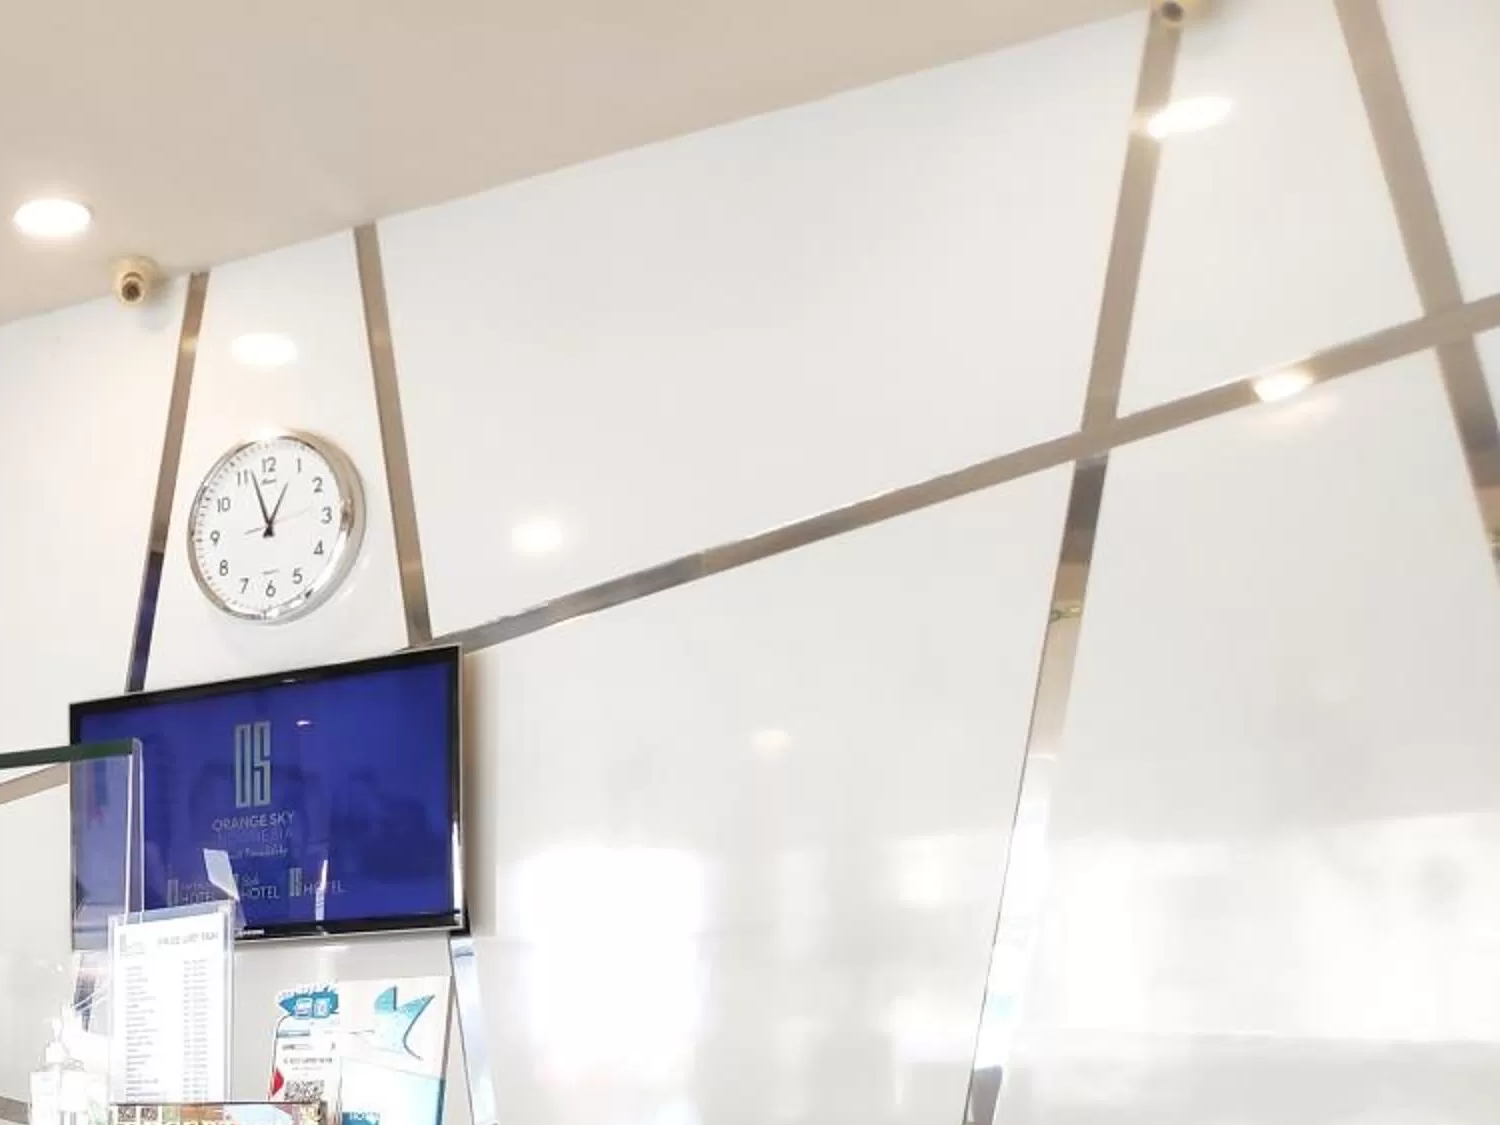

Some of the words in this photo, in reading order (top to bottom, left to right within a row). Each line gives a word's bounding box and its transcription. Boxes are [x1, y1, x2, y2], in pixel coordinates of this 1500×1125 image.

[261, 457, 276, 473] 12
[296, 457, 303, 474] 1
[237, 469, 249, 486] 11
[312, 477, 324, 493] 2
[217, 497, 231, 513] 10
[321, 507, 333, 524] 3
[210, 530, 220, 545] 9
[313, 541, 325, 556] 4
[219, 559, 229, 576] 8
[292, 568, 303, 584] 5
[239, 578, 249, 594] 7
[265, 580, 276, 597] 6
[234, 720, 271, 808] OS
[212, 814, 269, 832] ORANGE
[270, 809, 296, 827] SKY
